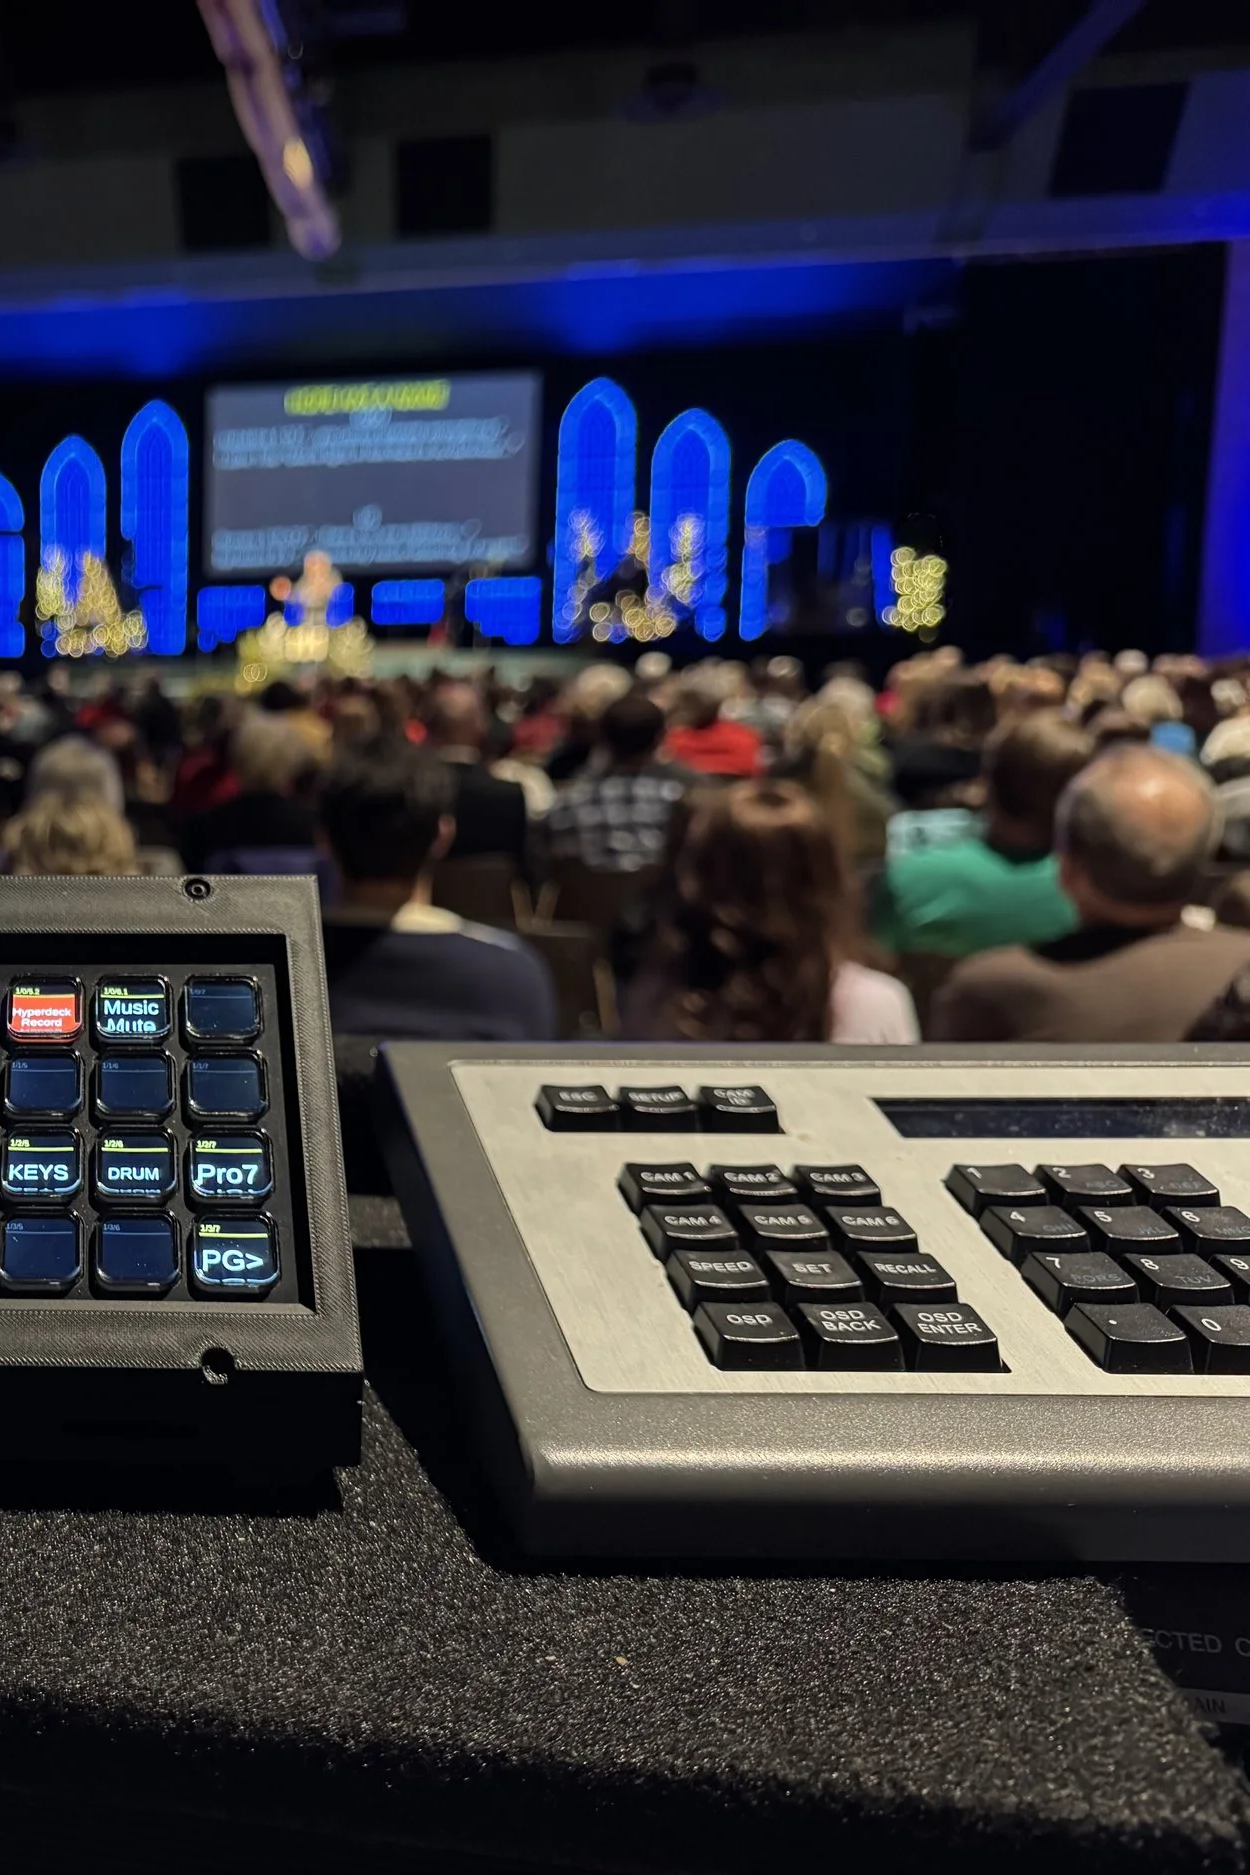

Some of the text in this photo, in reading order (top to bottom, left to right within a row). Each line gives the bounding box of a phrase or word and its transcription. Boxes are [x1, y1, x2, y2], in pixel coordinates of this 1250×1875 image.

[13, 1007, 72, 1019] Hyperdeck
[104, 999, 160, 1015] Music
[21, 1018, 63, 1027] Record
[107, 1018, 157, 1031] Mute
[714, 1088, 755, 1099] CAM
[9, 1164, 69, 1181] KEYS
[108, 1167, 160, 1181] DRUM
[197, 1164, 259, 1185] Pro7
[641, 1171, 696, 1183] CAM 1
[724, 1172, 780, 1183] CAM 2
[810, 1172, 867, 1183] CAM 3
[966, 1167, 982, 1179] 1
[1052, 1167, 1073, 1179] 2
[1137, 1167, 1155, 1179] 3
[664, 1215, 722, 1227] CAM 4
[754, 1215, 811, 1227] CAM 5
[842, 1215, 900, 1227] CAM 6
[1010, 1211, 1026, 1223] 4
[1094, 1210, 1112, 1223] 5
[1181, 1211, 1200, 1223] 6
[203, 1249, 264, 1272] PG>
[689, 1260, 754, 1273] SPEED
[1046, 1256, 1061, 1269] 7
[1140, 1258, 1160, 1271] 8
[1230, 1258, 1250, 1270] 9
[793, 1263, 831, 1275] SET
[875, 1263, 937, 1275] RECALL
[726, 1314, 772, 1328] OSD
[820, 1310, 865, 1322] OSD
[918, 1312, 963, 1323] OSD
[821, 1320, 882, 1333] BACK
[919, 1322, 982, 1335] ENTER
[1201, 1318, 1222, 1331] 0
[1141, 1628, 1222, 1653] ECTED
